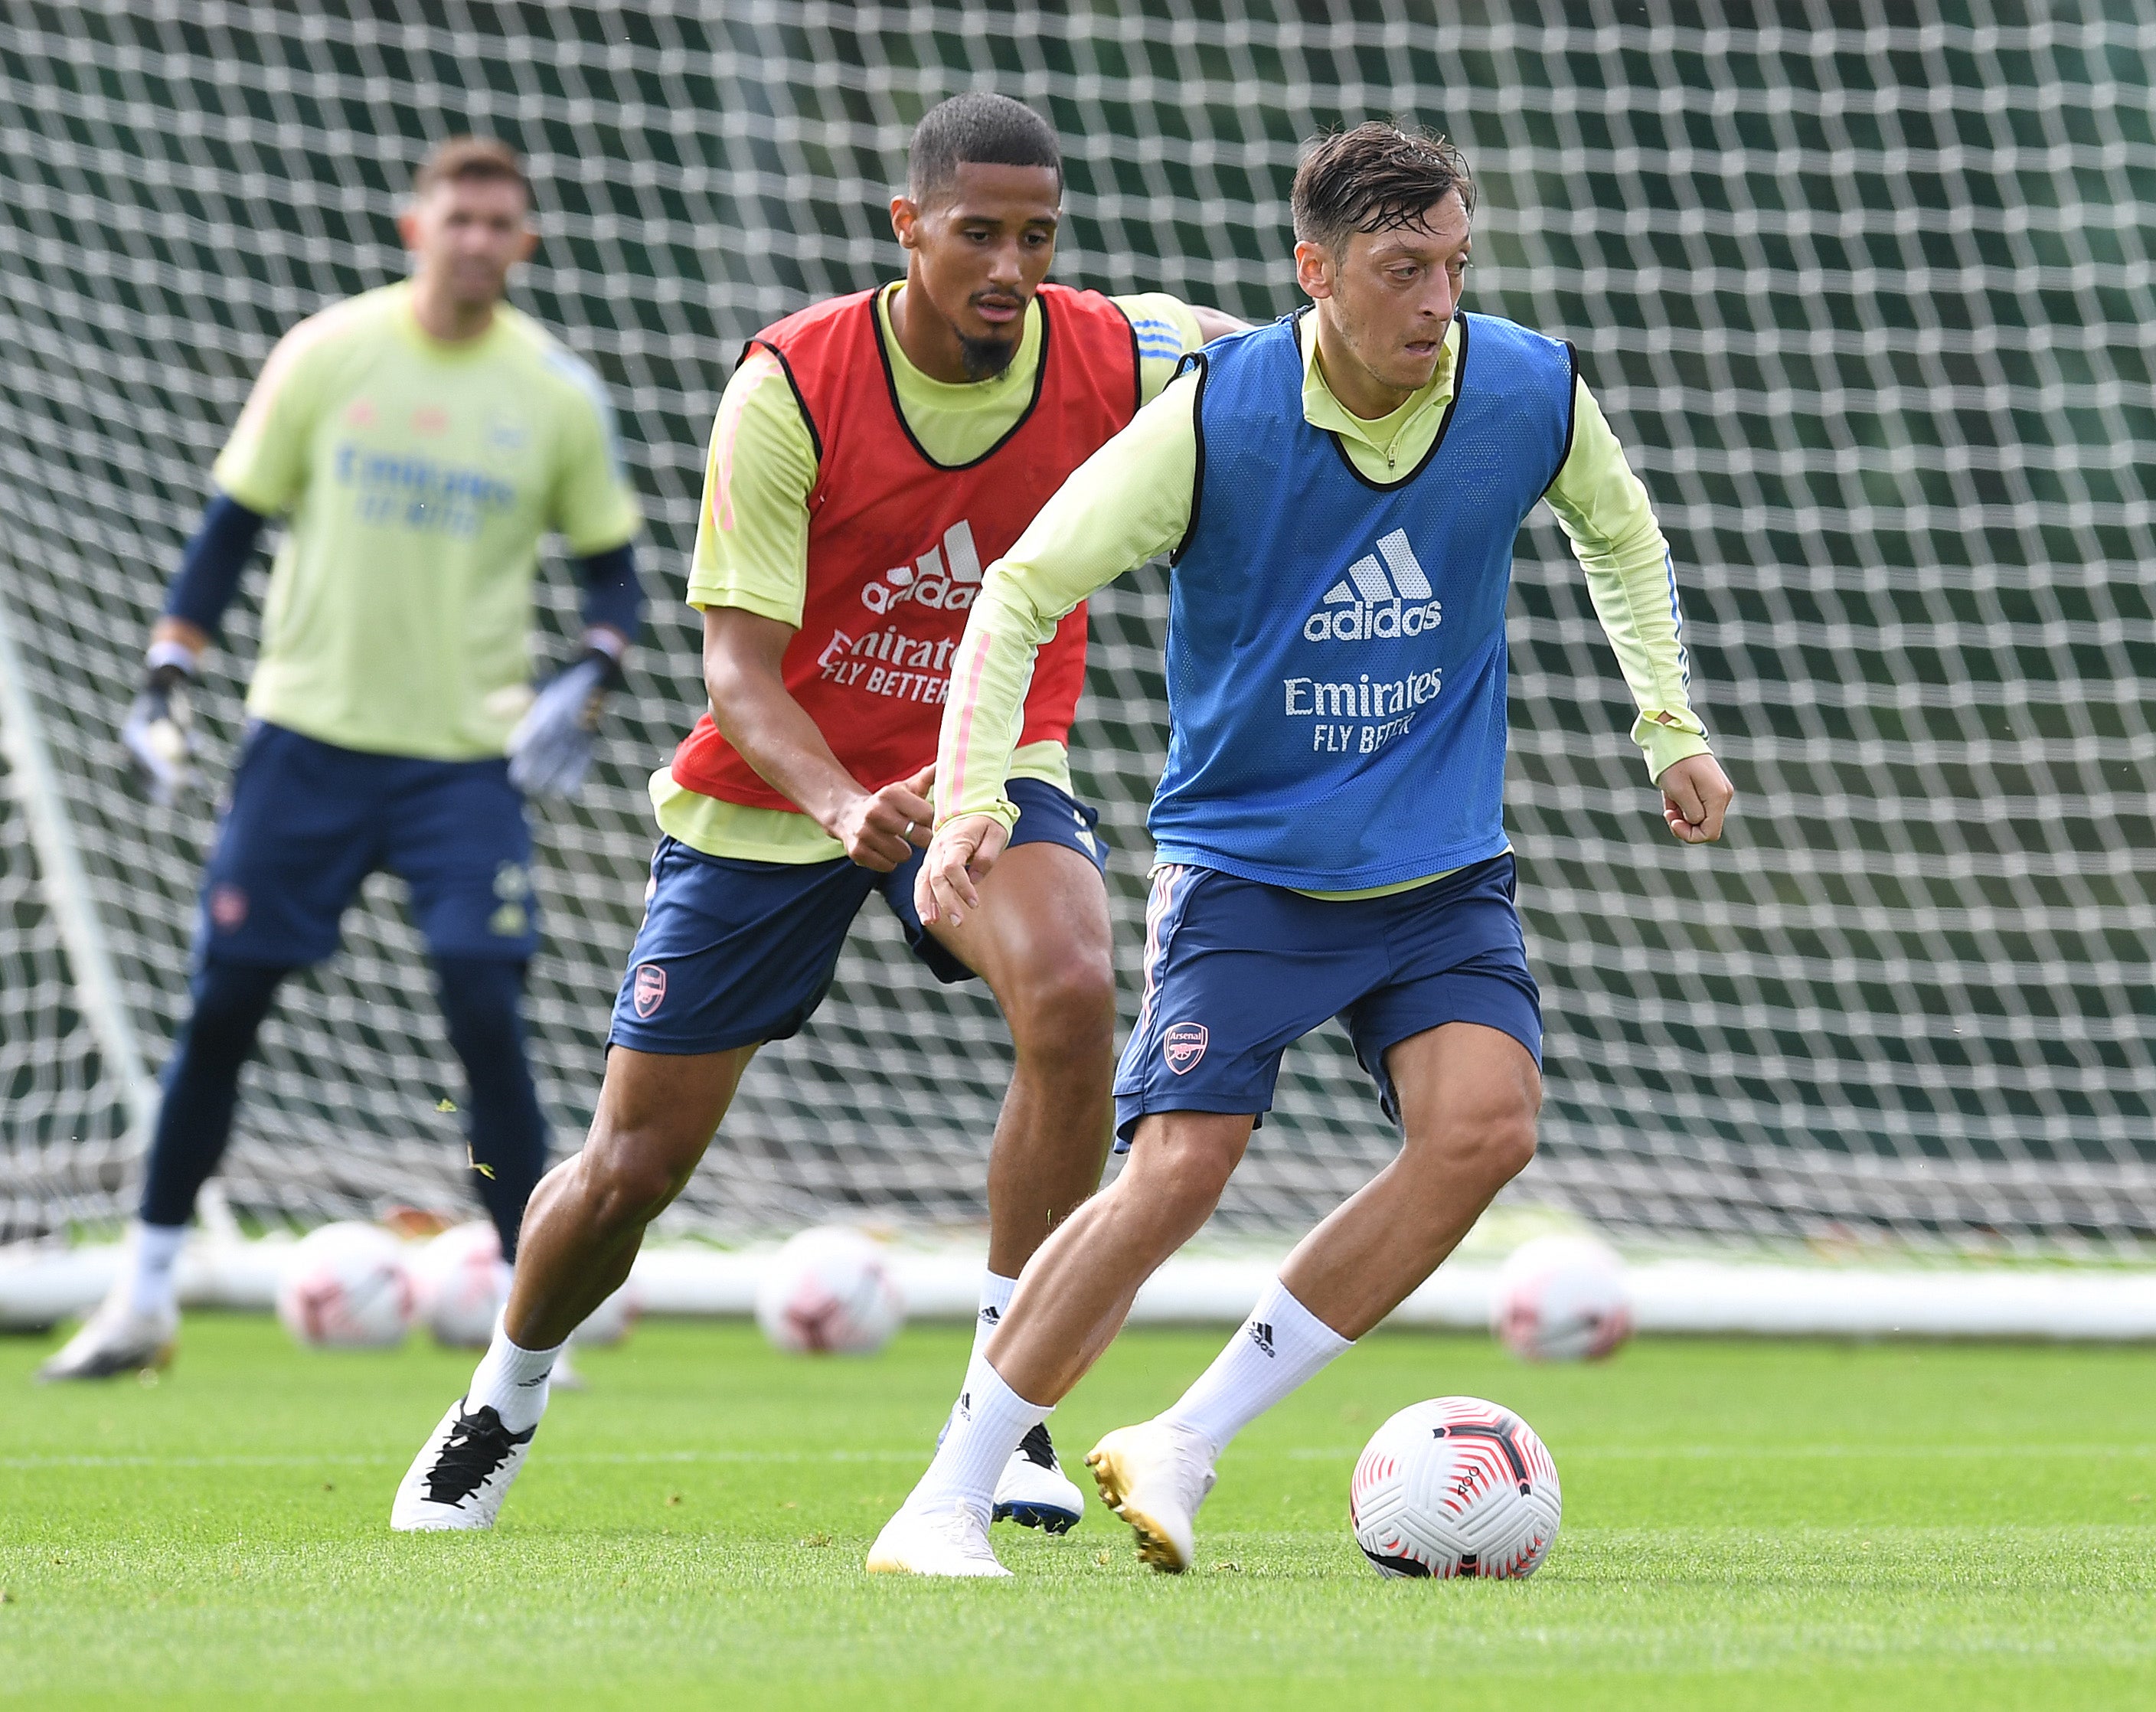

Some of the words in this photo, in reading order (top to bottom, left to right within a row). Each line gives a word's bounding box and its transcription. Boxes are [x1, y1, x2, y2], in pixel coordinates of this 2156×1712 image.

[1304, 597, 1442, 642] adidas
[1283, 668, 1442, 717] Emirates
[1314, 724, 1354, 752] FLY
[1170, 1032, 1201, 1041] Arsenal
